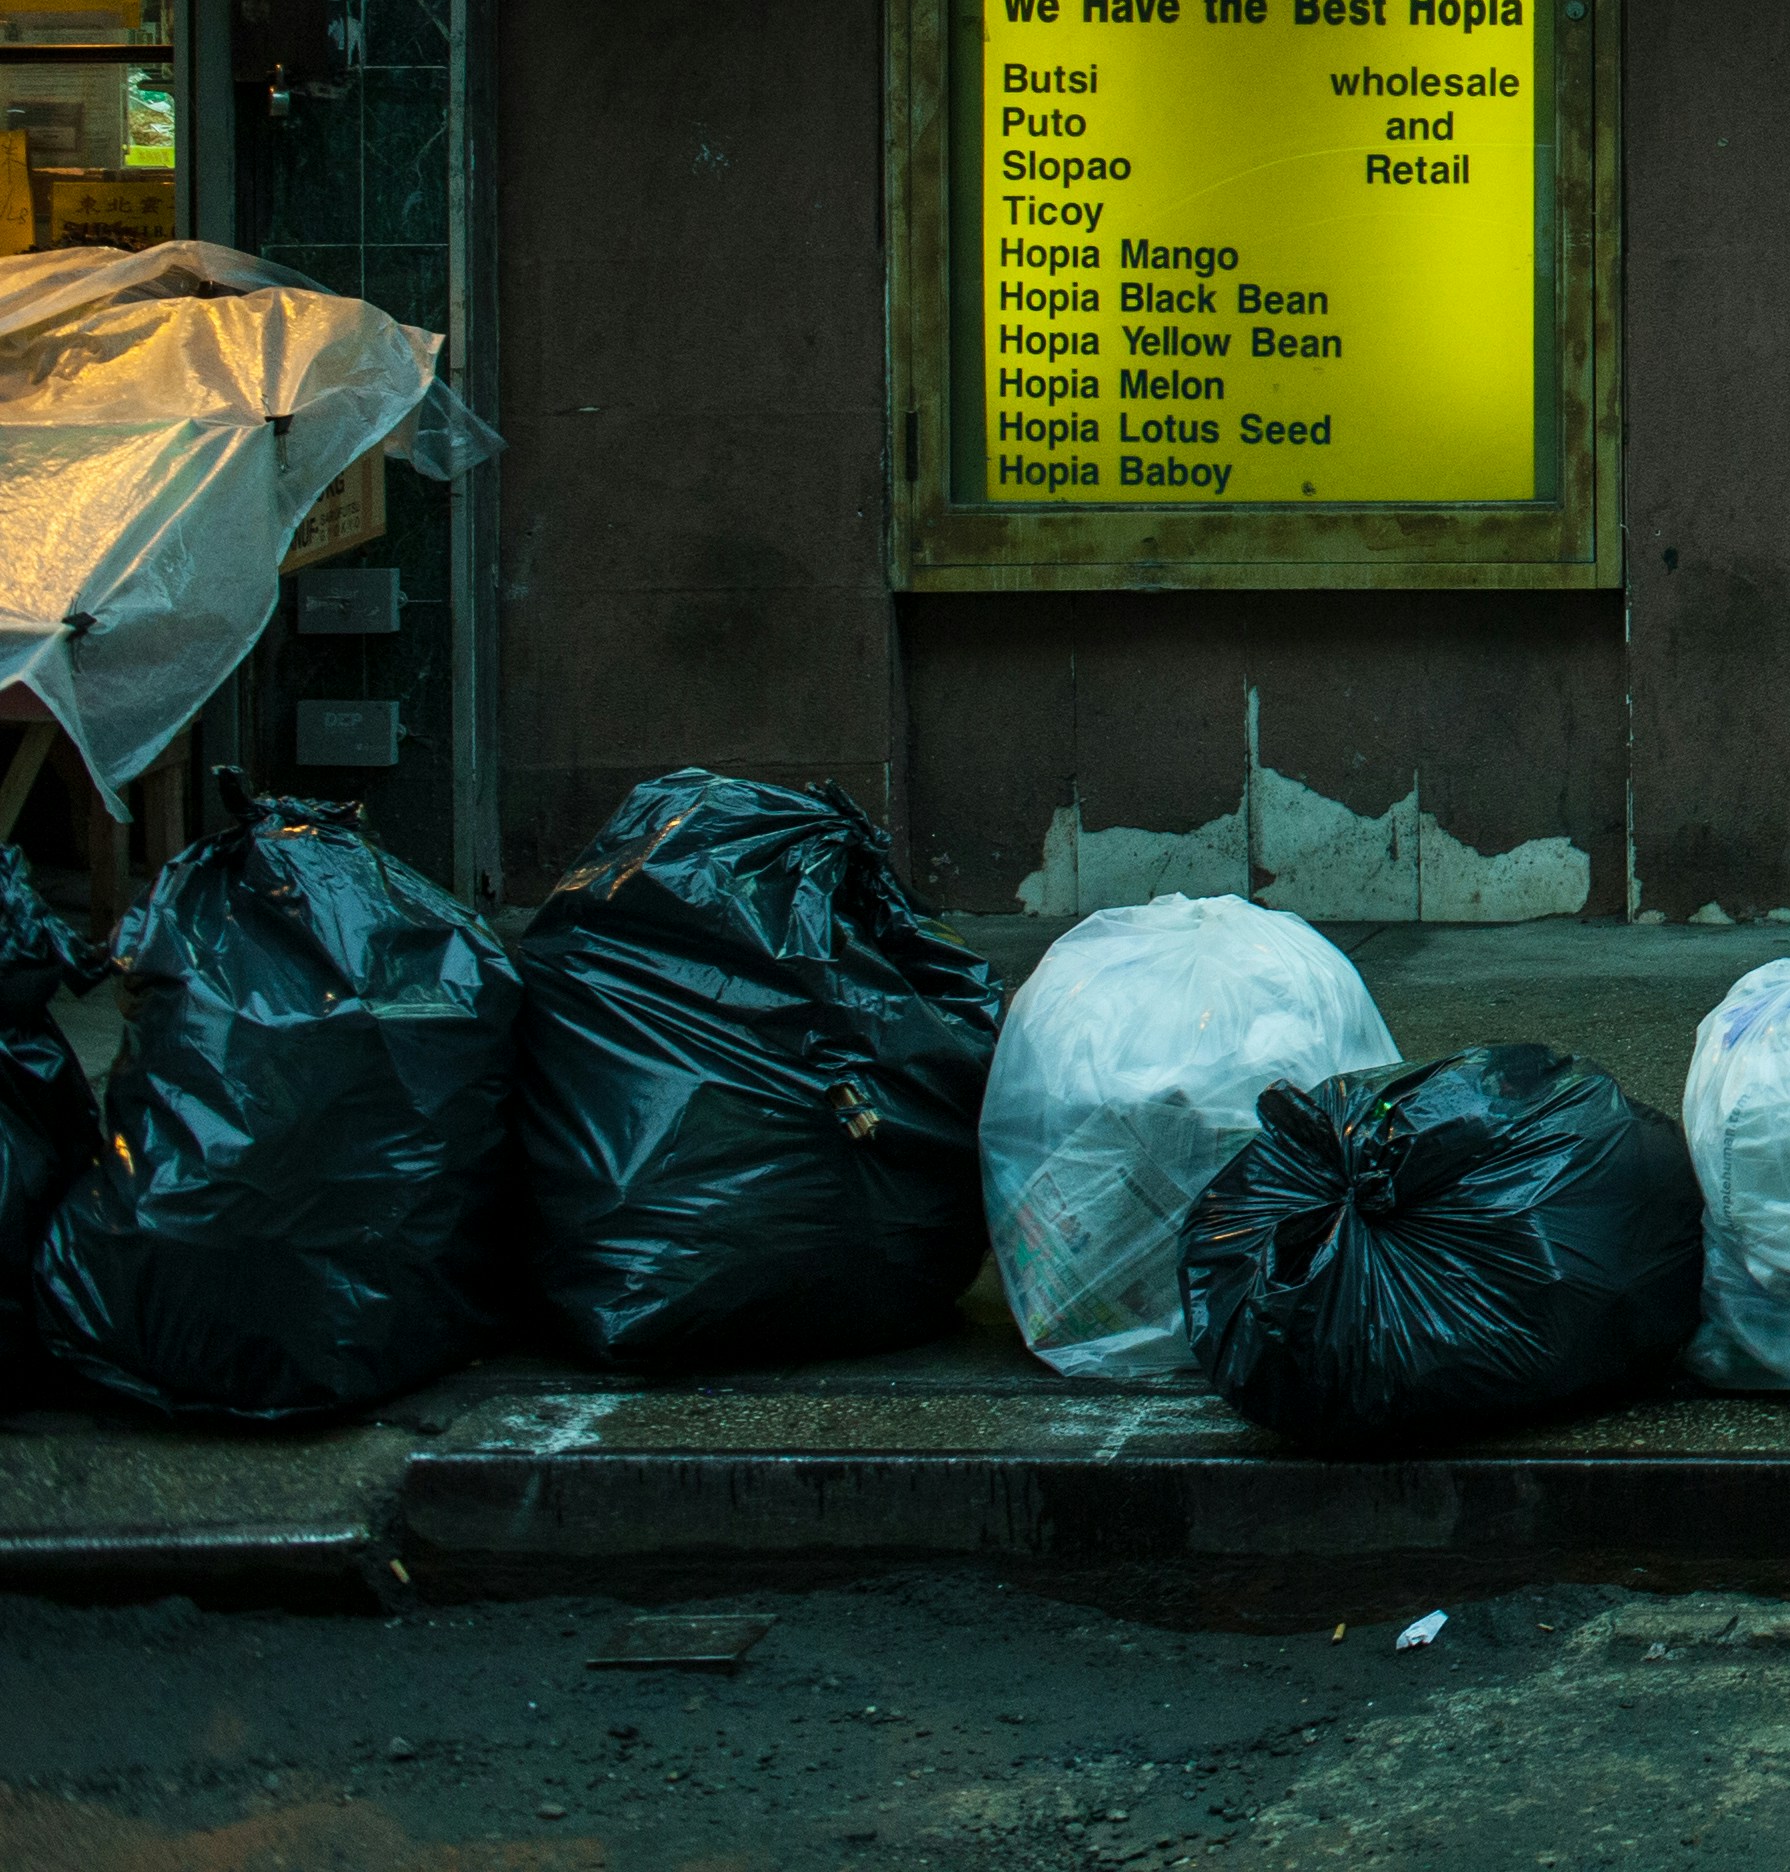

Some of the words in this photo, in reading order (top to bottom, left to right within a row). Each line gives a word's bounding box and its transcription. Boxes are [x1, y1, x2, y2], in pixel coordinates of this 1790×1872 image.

[1003, 63, 1099, 94] Butsi
[1330, 68, 1520, 98] wholesale
[1002, 108, 1086, 138] Puto
[1385, 112, 1455, 141] and
[1002, 151, 1132, 189] Slopao
[1366, 155, 1470, 185] Retail
[1003, 196, 1104, 234] Ticoy
[1120, 239, 1239, 278] Mango
[1000, 282, 1100, 319] Hopia
[1120, 283, 1217, 315] Black
[1237, 284, 1329, 315] Bean
[1122, 327, 1231, 358] Yellow
[1251, 328, 1343, 359] Bean
[1000, 369, 1100, 407] Hopia
[1120, 370, 1225, 401] Melon
[1000, 412, 1100, 450] Hopia
[1120, 414, 1220, 445] Lotus
[1240, 414, 1332, 446] Seed
[1000, 455, 1100, 493] Hopia
[1120, 457, 1232, 495] Baboy
